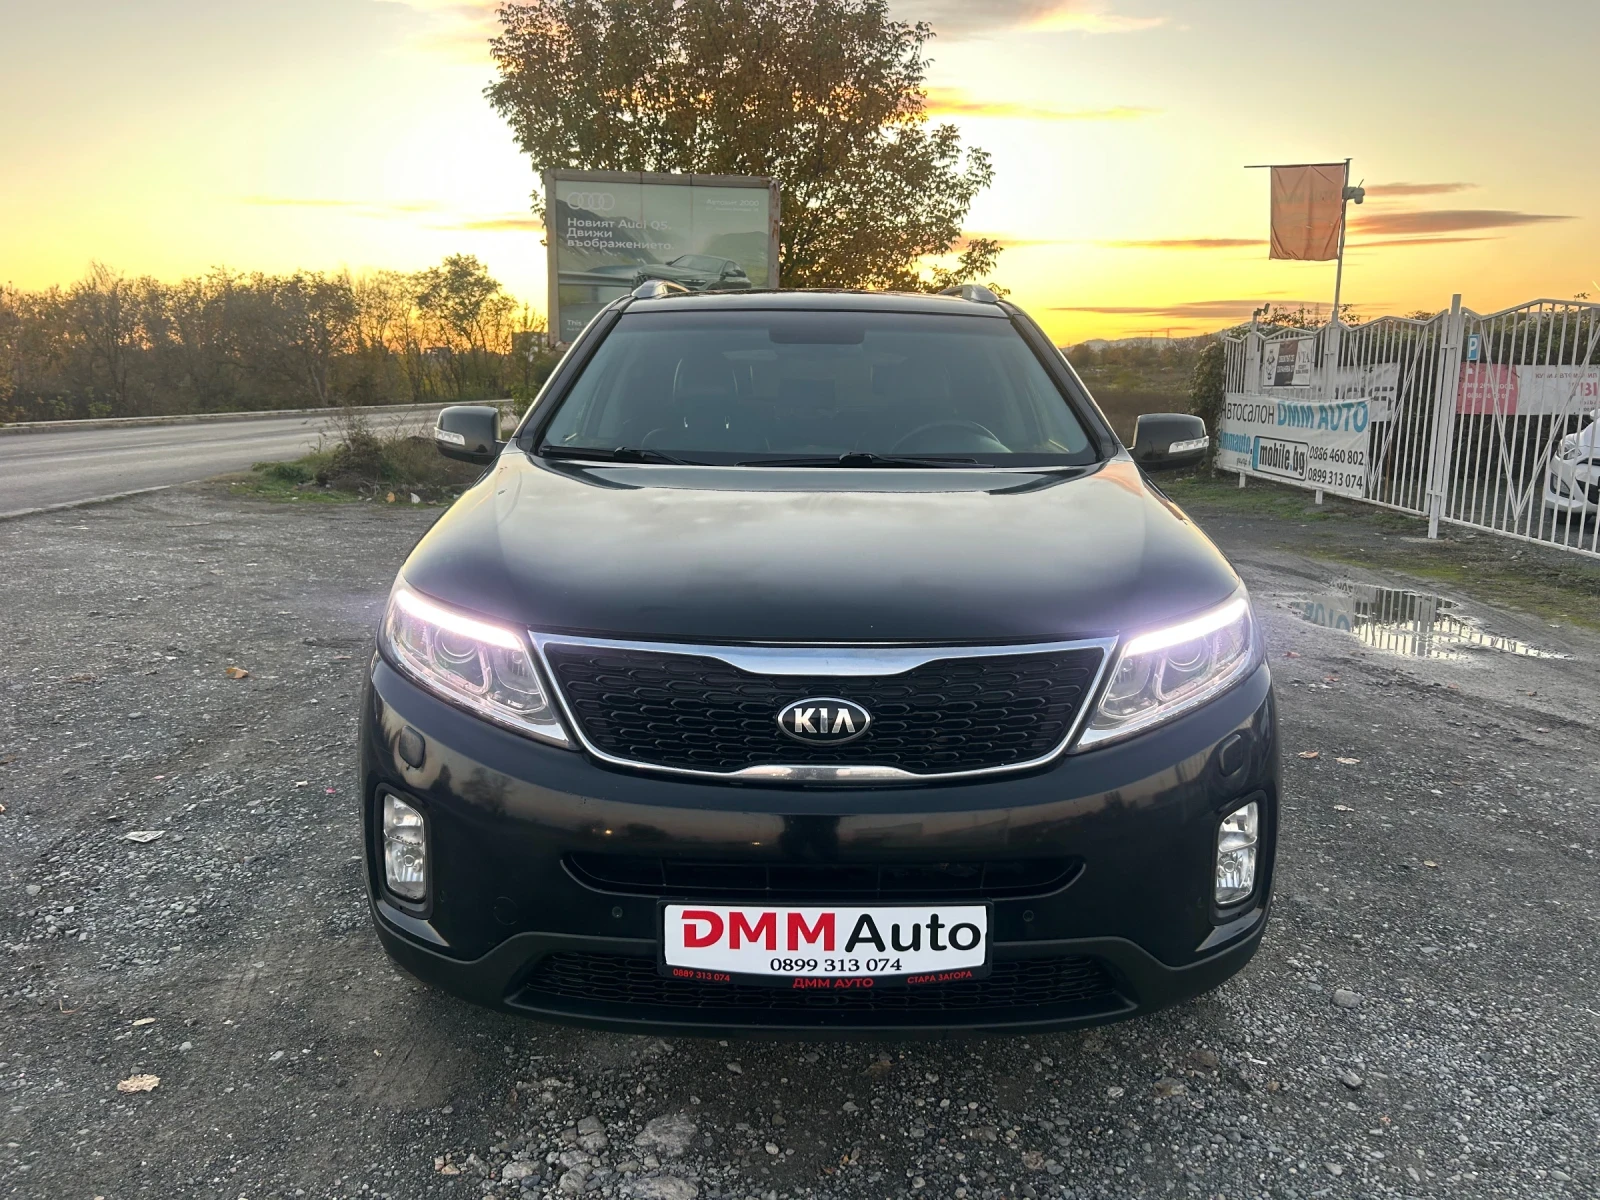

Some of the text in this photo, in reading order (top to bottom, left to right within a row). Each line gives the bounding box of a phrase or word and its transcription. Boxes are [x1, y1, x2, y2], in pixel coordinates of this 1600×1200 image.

[567, 217, 615, 228] Новият
[618, 219, 647, 230] Audi
[566, 227, 613, 239] Движи
[567, 239, 675, 250] въображението.
[1468, 337, 1478, 358] P
[1221, 396, 1368, 433] Автосалон DMM AUTO
[1309, 445, 1364, 466] 0886 460 802
[1308, 467, 1363, 490] 0899 313 074
[793, 707, 856, 734] KIA
[681, 909, 982, 953] DMM Auto
[770, 958, 902, 972] 0899 313 074
[672, 968, 731, 982] 0889 313 074
[907, 970, 973, 984] СТАРА ЗАГОРА
[792, 977, 874, 989] ДММ АУТО
